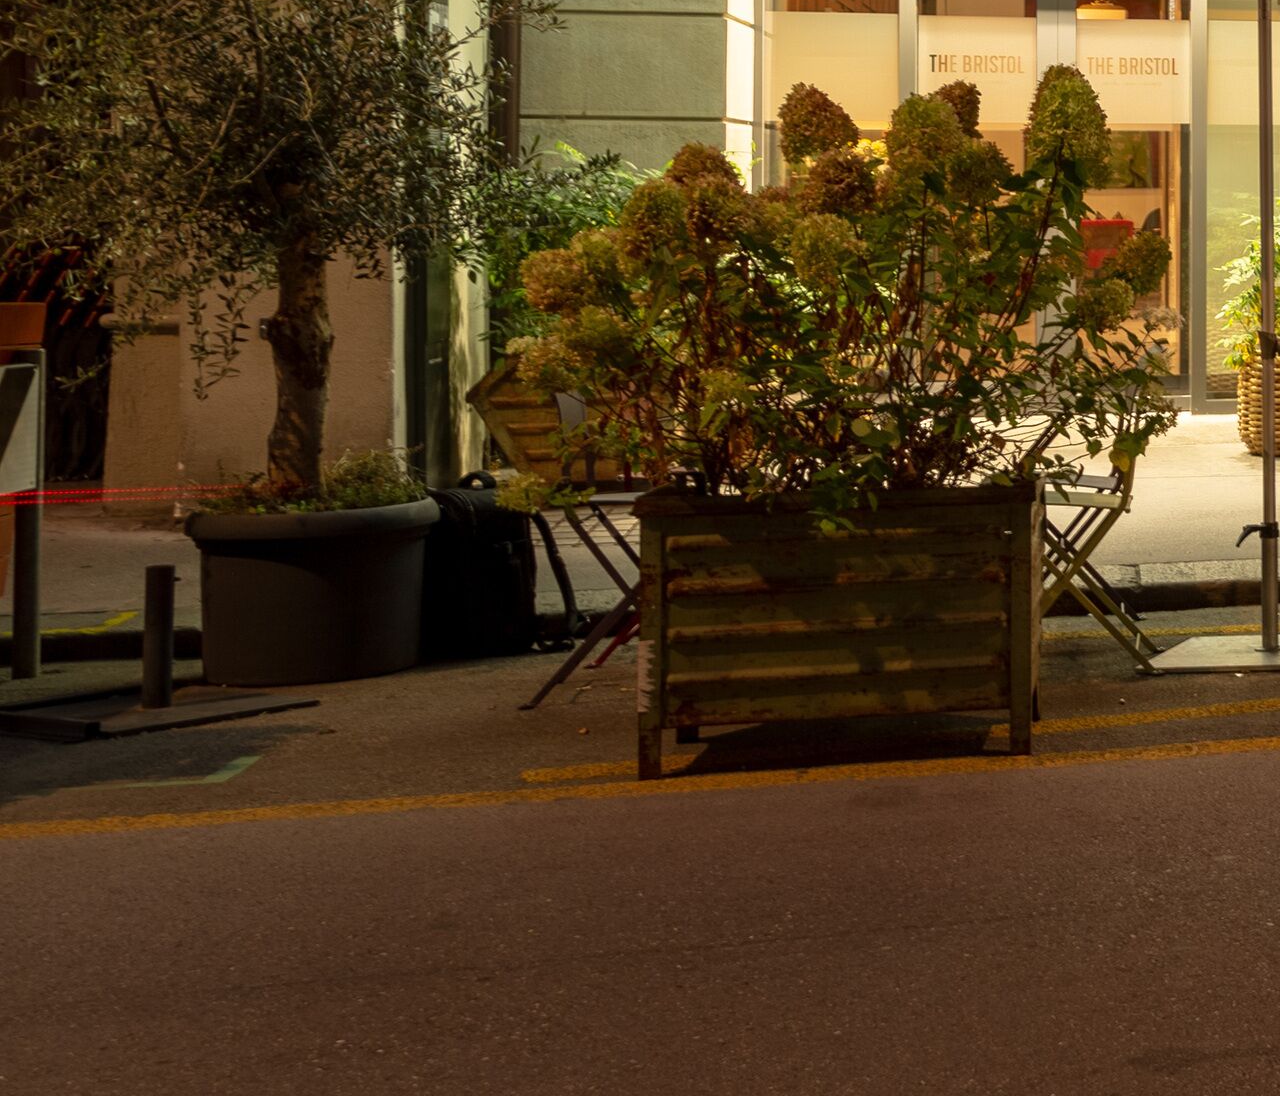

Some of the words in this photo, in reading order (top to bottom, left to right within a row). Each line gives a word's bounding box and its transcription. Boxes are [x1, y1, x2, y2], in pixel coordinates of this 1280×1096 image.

[929, 54, 958, 73] THE
[963, 54, 1025, 74] BRISTOL
[1087, 56, 1113, 75] THE
[1119, 56, 1179, 76] BRISTOL
